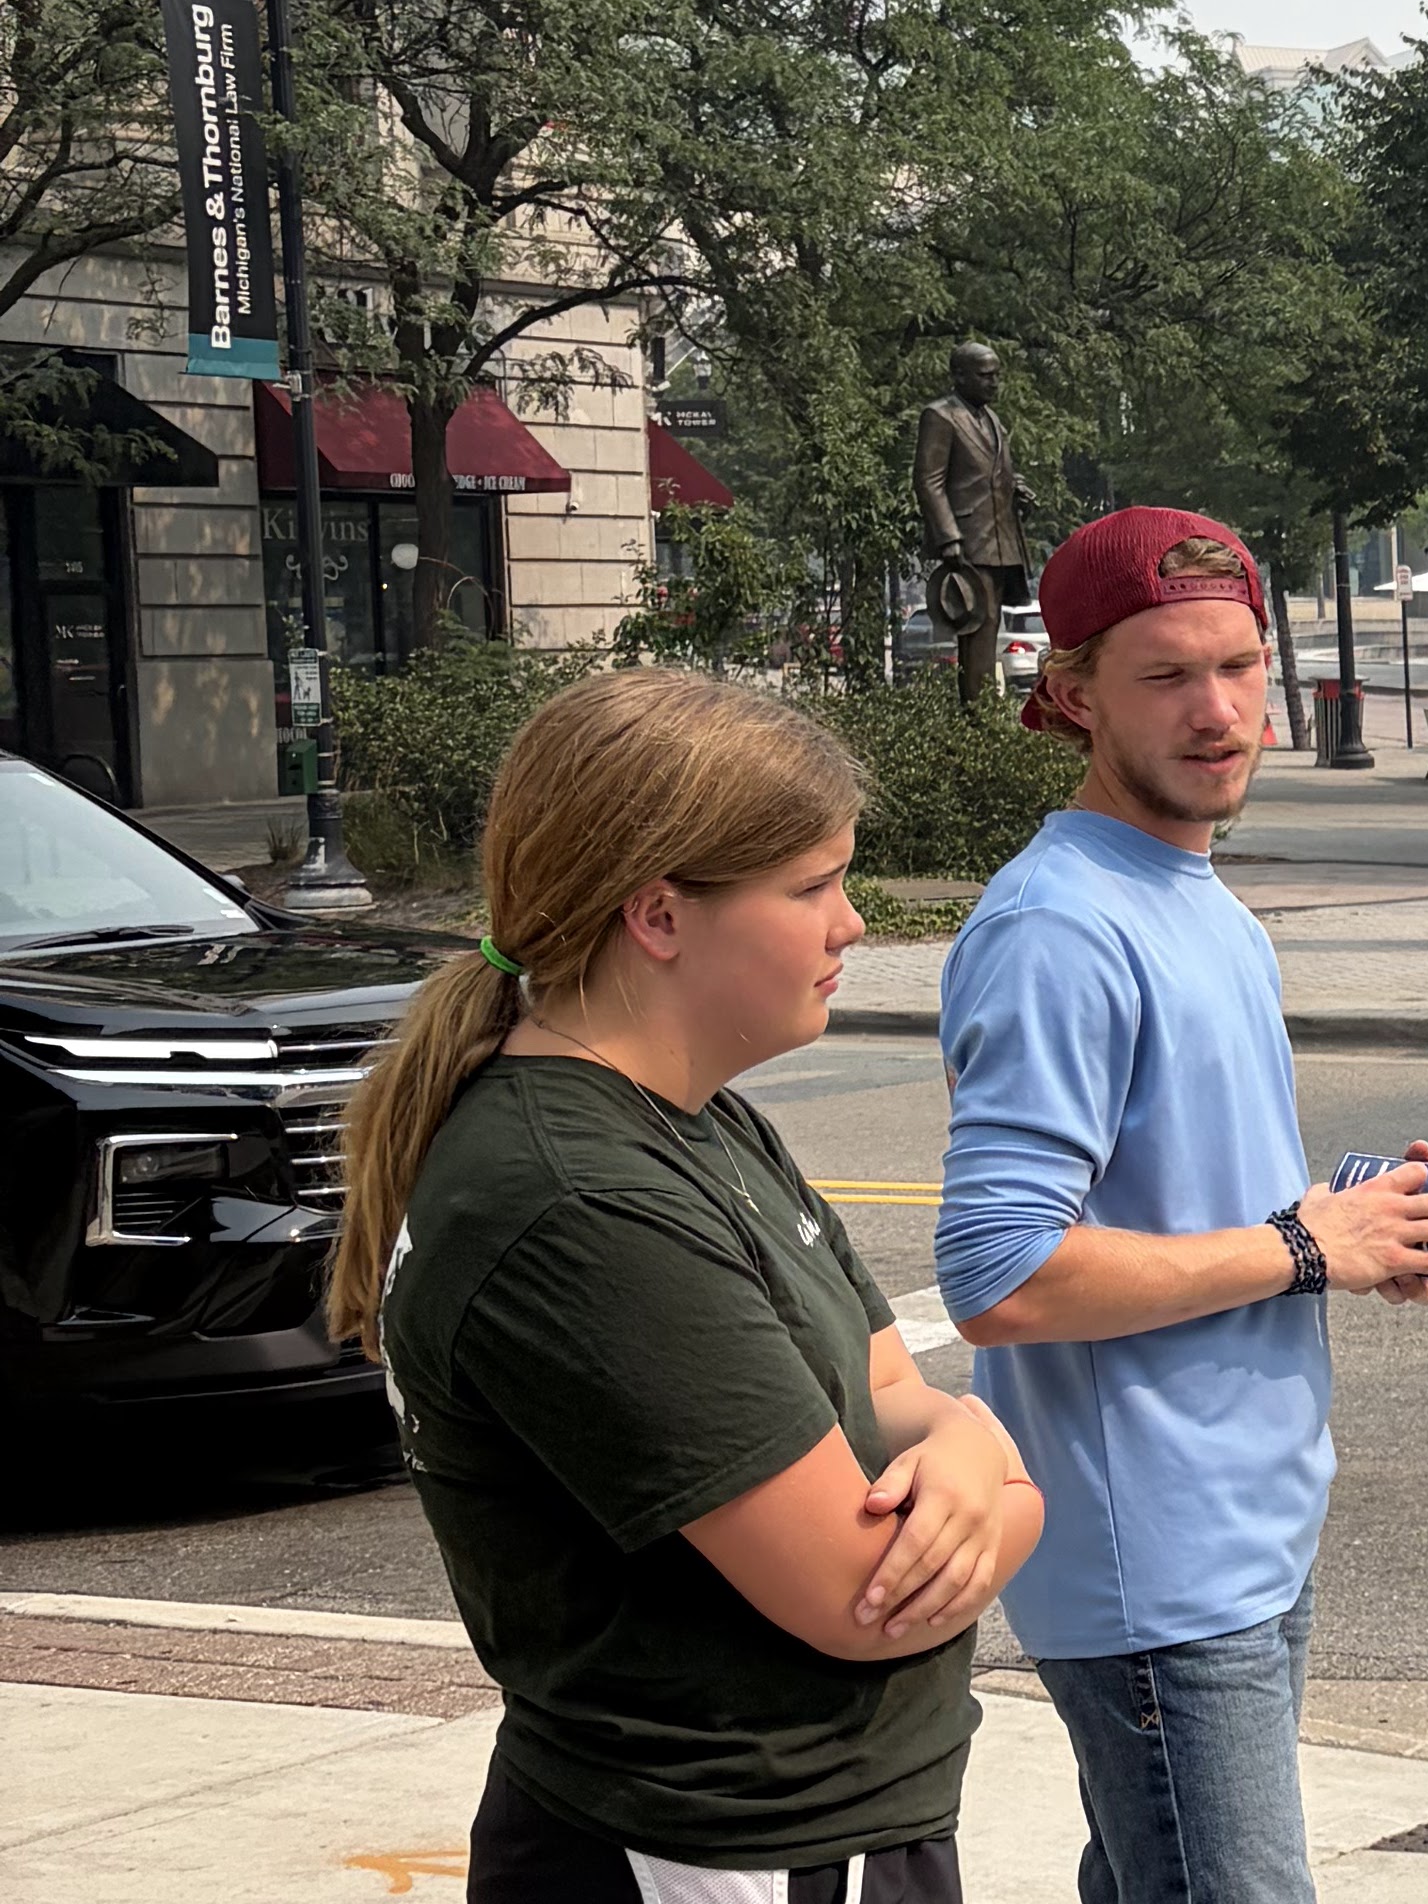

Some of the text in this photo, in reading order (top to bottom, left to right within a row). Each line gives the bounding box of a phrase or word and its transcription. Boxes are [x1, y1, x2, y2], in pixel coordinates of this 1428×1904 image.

[192, 3, 232, 349] Barnes & Thornburg
[220, 24, 252, 314] Michigan's National Law Firm
[262, 507, 370, 542] Kiins
